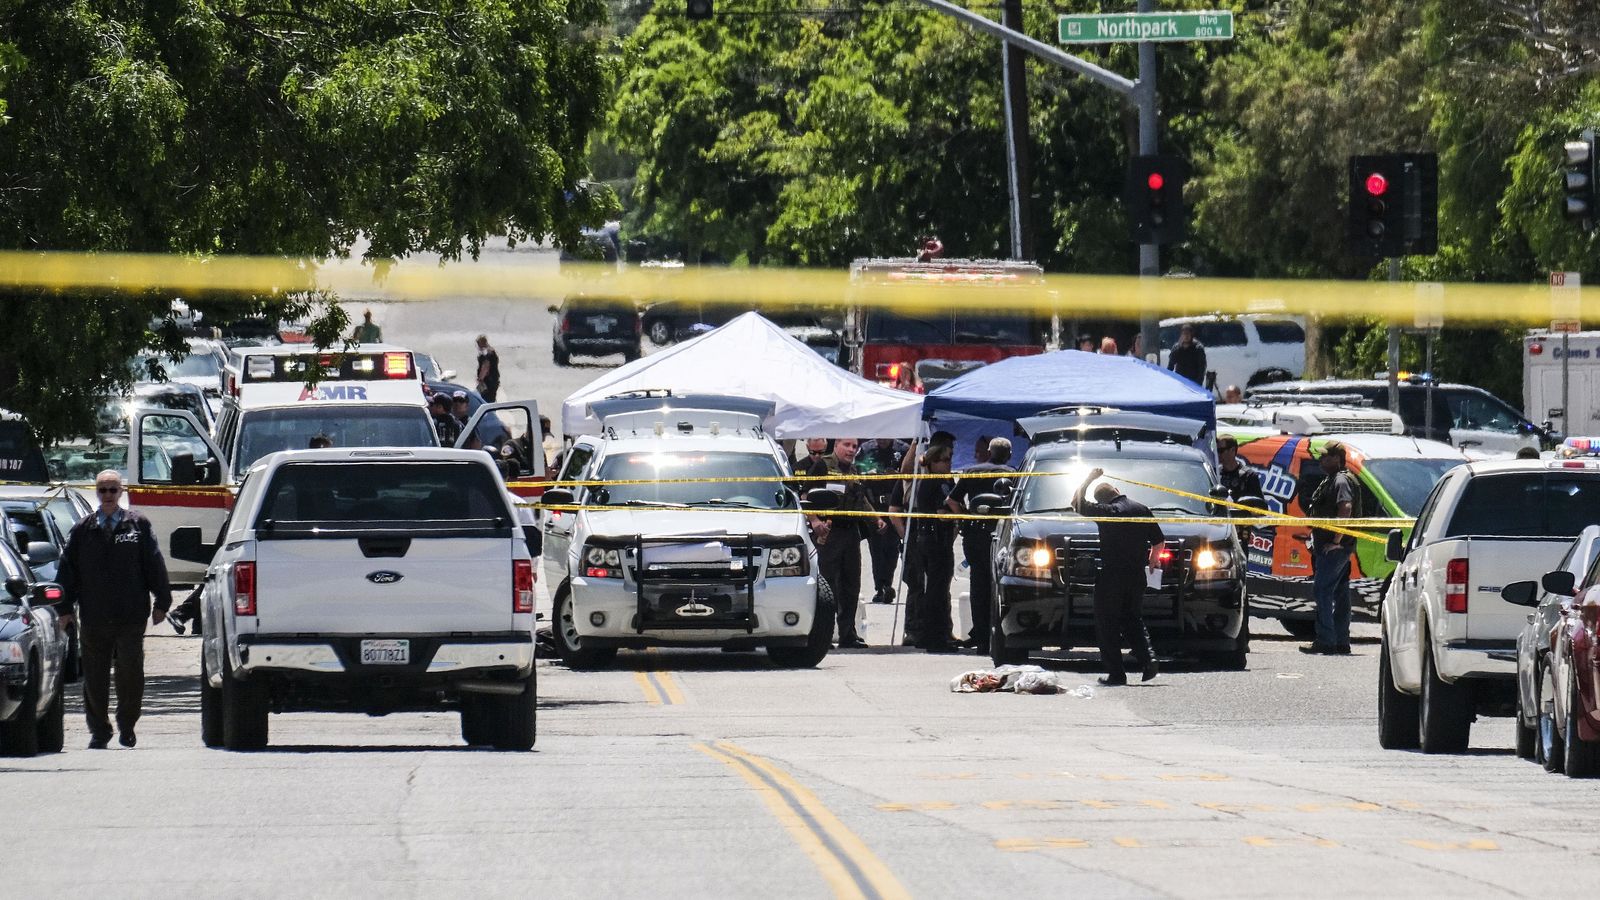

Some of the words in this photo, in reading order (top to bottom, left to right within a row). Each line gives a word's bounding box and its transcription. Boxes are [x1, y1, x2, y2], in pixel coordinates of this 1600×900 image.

[1199, 15, 1217, 25] Blvd
[1097, 18, 1178, 38] Northpark
[1195, 26, 1213, 36] 800
[1215, 26, 1223, 35] W
[1552, 274, 1564, 286] NO
[297, 385, 368, 401] AMR
[115, 531, 138, 544] POLICE
[1248, 553, 1273, 566] RIALTO
[1478, 585, 1502, 593] F15
